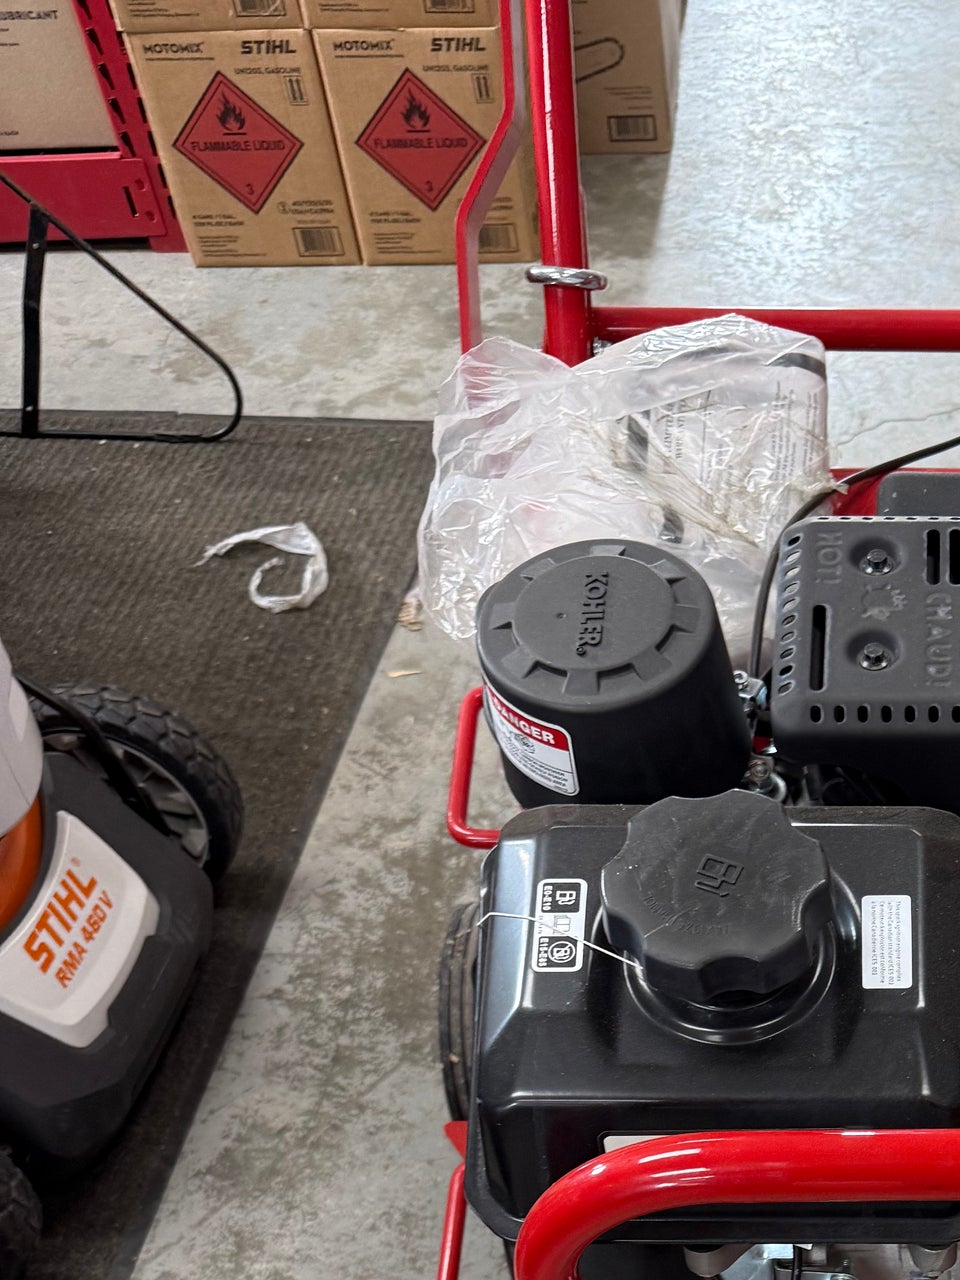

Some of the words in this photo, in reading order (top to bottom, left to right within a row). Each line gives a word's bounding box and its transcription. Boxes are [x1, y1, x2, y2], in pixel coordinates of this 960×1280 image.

[142, 42, 203, 54] MOTOMIX
[241, 40, 296, 54] STIHL
[332, 40, 393, 51] MOTOMIX
[430, 37, 486, 52] STIHL
[191, 141, 251, 152] FLAMMABLE
[253, 139, 286, 151] LIQUID
[373, 138, 433, 149] FLAMMABLE
[436, 137, 469, 149] LIQUID
[245, 183, 255, 196] 3
[424, 180, 434, 192] 3
[578, 571, 609, 647] KOHLER
[493, 696, 556, 745] DANGER
[542, 885, 553, 911] E0-E10
[23, 868, 98, 975] STIHL
[54, 941, 88, 989] RMA
[81, 902, 108, 943] 460
